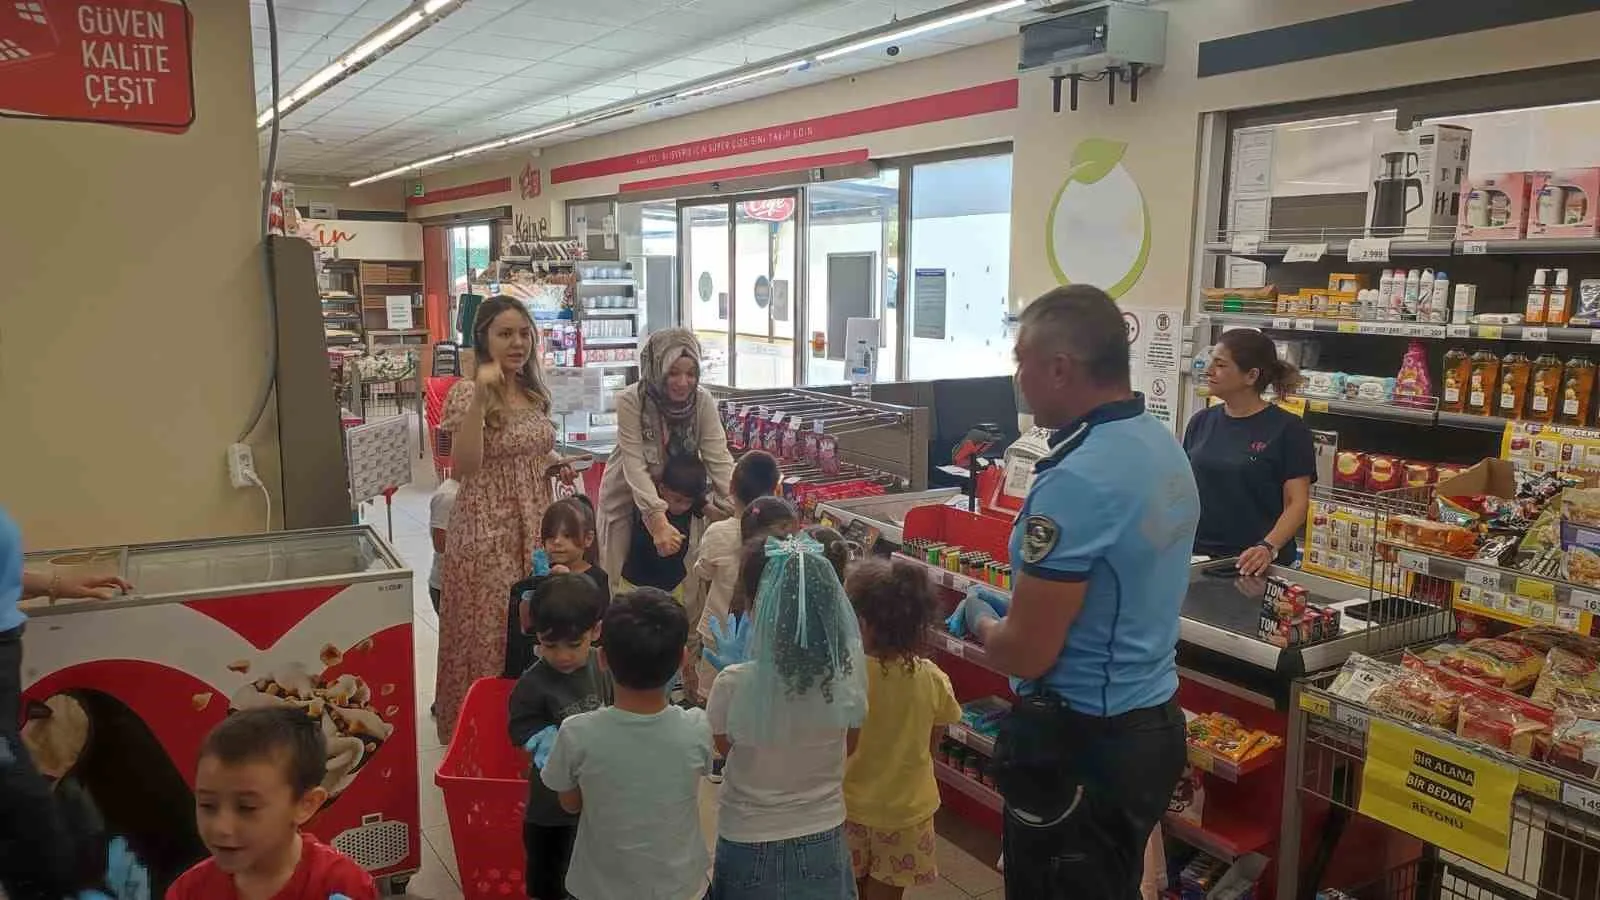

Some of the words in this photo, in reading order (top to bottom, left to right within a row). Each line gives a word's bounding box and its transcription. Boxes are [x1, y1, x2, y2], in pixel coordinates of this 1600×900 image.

[78, 5, 164, 40] GÜVEN
[81, 39, 171, 73] KALİTE
[84, 73, 157, 110] ÇEŞİT
[1414, 753, 1432, 768] BİR
[1435, 763, 1474, 784] ALANA
[1407, 775, 1425, 790] BİR
[1427, 783, 1472, 810] BEDAVA
[1411, 801, 1464, 829] REYONU
